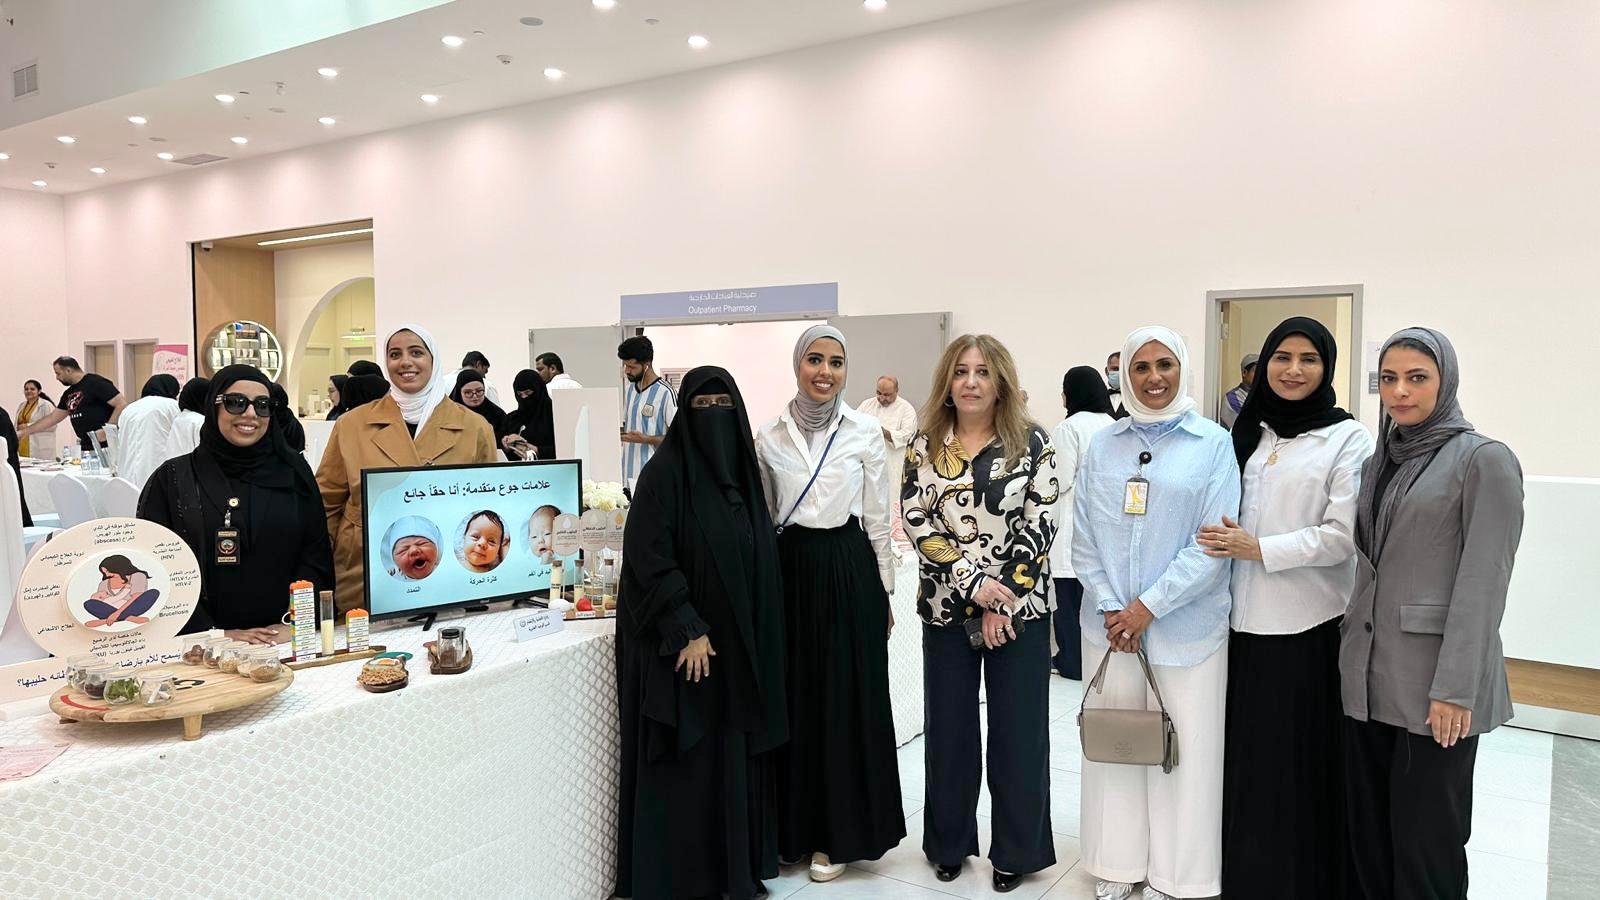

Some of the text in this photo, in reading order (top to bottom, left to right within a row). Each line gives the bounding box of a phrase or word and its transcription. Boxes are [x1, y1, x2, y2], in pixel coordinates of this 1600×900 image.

[688, 304, 757, 314] Outpatient Pharmacy
[449, 483, 460, 495] أنا
[463, 482, 496, 496] متقدمة:
[499, 484, 519, 496] جوع
[522, 480, 550, 490] علامات
[403, 488, 426, 502] جائع
